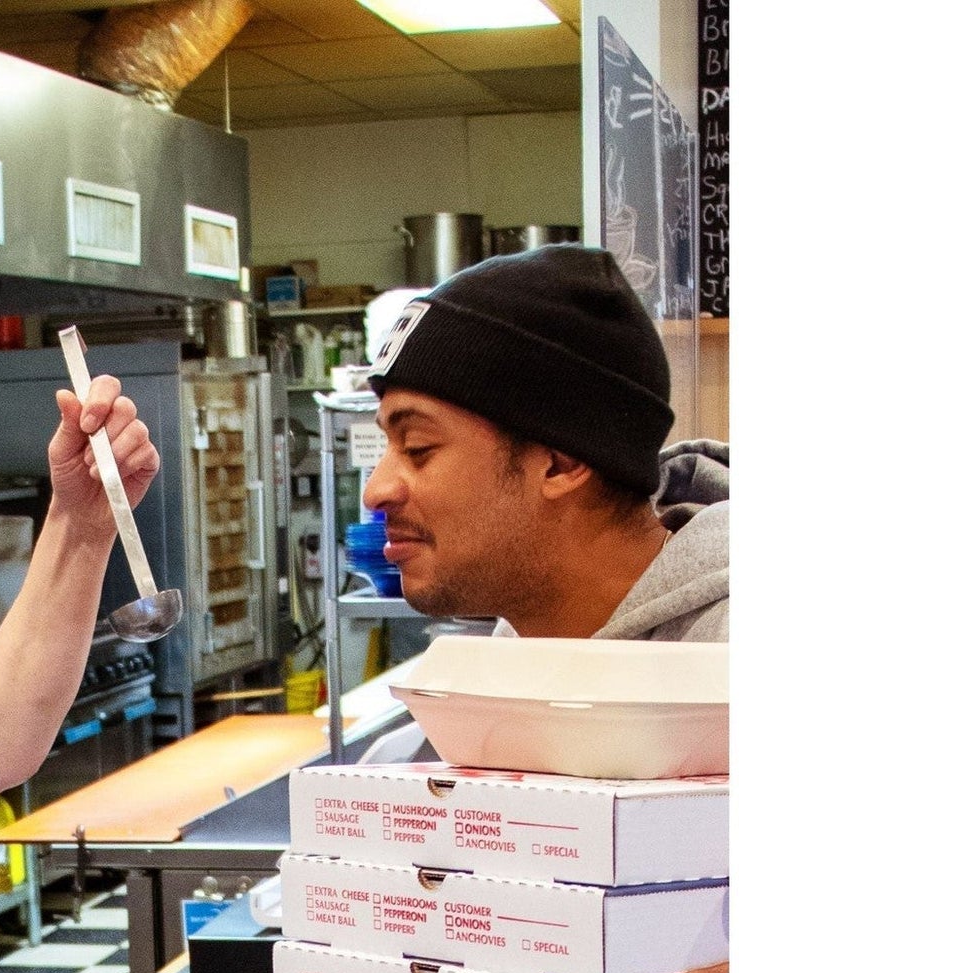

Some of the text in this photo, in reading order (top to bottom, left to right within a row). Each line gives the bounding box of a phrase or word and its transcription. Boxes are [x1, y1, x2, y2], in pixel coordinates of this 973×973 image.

[324, 799, 379, 812] EXTRA CHEESE
[393, 805, 447, 818] MUSHROOMS
[324, 812, 360, 824] SAUSAGE
[454, 809, 501, 822] CUSTOMER
[394, 818, 437, 831] PEPPERONI
[465, 823, 501, 836] ONIONS
[325, 826, 366, 838] MEAT BALL
[394, 832, 425, 844] PEPPERS
[466, 838, 516, 852] ANCHOVIES
[543, 845, 579, 858] SPECIAL
[314, 886, 369, 901] EXTRA CHEESE
[315, 900, 350, 912] SAUSAGE
[383, 895, 437, 911] MUSHROOMS
[444, 902, 492, 917] CUSTOMER
[315, 913, 356, 927] MEAT BALL
[384, 908, 427, 922] PEPPERONI
[384, 922, 416, 935] PEPPERS
[455, 917, 491, 931] ONIONS
[455, 931, 506, 947] ANCHOVIES
[533, 941, 569, 955] SPECIAL
